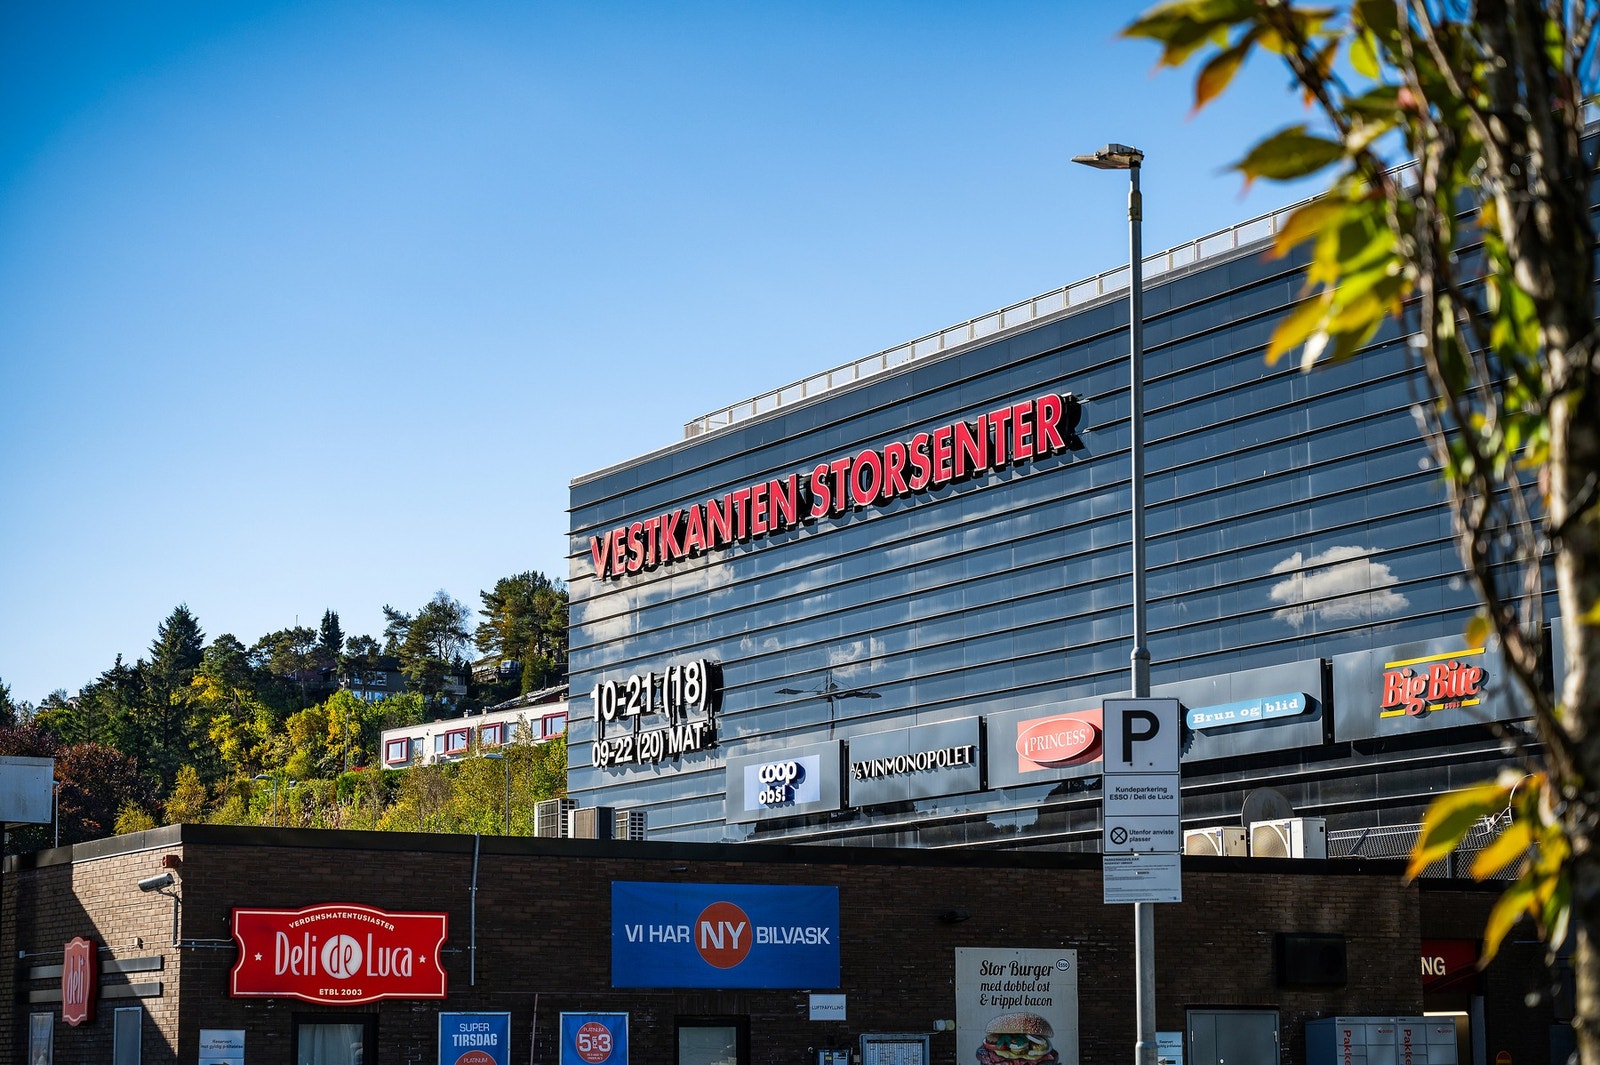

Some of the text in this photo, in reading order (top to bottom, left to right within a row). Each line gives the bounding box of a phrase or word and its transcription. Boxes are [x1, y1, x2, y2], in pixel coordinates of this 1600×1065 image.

[589, 393, 1066, 580] VESTKANTEN STORSENTER
[590, 658, 707, 722] 10-21 (18)
[1380, 660, 1481, 716] Big Bite
[1192, 698, 1299, 724] Brun og blid
[592, 722, 704, 767] 09-22 (20) MAT
[1029, 728, 1087, 752] PRINCESS
[1122, 710, 1160, 762] P
[862, 745, 972, 778] VINMONOPOLET
[758, 761, 797, 805] coop obs!
[289, 912, 395, 931] VERDENSMATENTUSIASTER
[625, 921, 830, 949] VI HAR NY BILVASK
[275, 931, 317, 976] Deli
[366, 933, 413, 977] Luca
[67, 955, 85, 1005] deli
[980, 960, 1054, 980] Stor Burger
[319, 988, 363, 996] ETBL 2003
[980, 980, 1050, 992] med dobbel ost
[980, 993, 1053, 1009] & trippel bacon
[452, 1033, 498, 1047] TIRSDAG
[459, 1022, 490, 1032] SUPER
[578, 1033, 592, 1052] 5
[597, 1033, 611, 1052] 3
